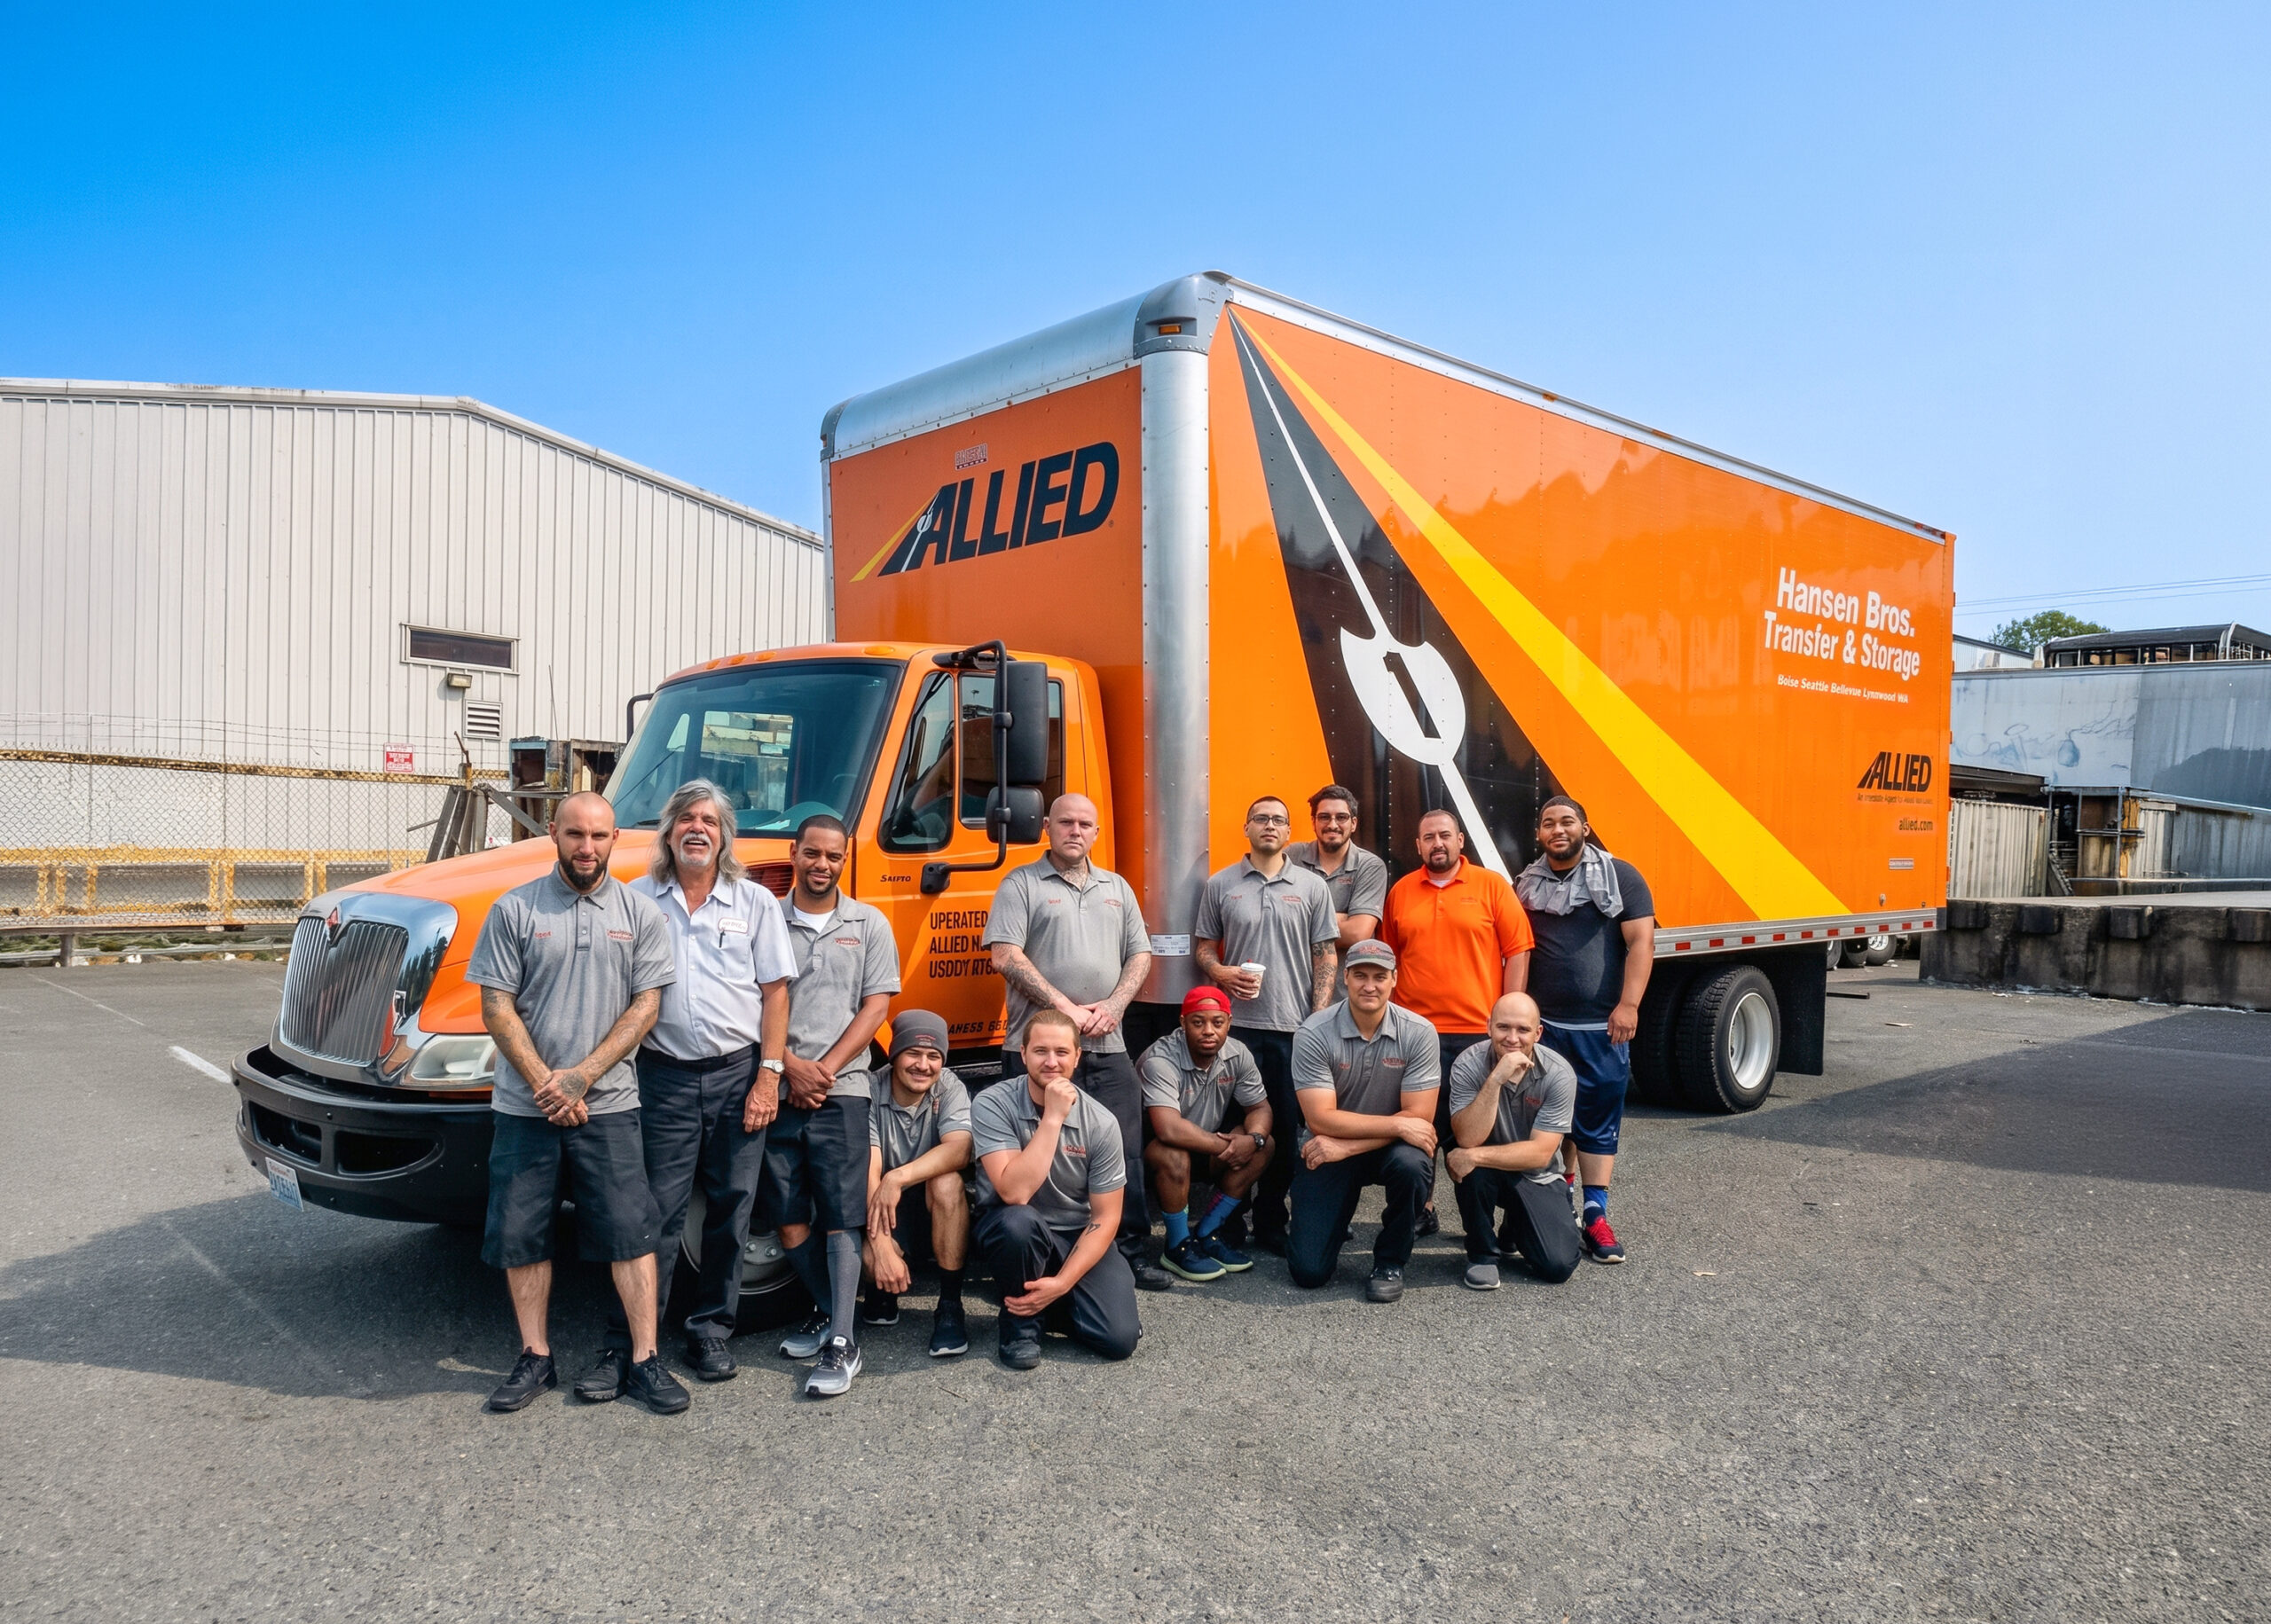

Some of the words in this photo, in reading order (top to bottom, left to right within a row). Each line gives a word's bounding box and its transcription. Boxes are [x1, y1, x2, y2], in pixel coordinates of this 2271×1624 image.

[877, 442, 1120, 577] ALLIED
[1777, 567, 1859, 624] Hansen
[1865, 591, 1915, 638] Bros.
[1843, 629, 1857, 665] &
[1861, 632, 1921, 682] Storage
[1778, 674, 1799, 688] Boise
[1831, 682, 1861, 697] Bellevue
[1863, 688, 1896, 702] Lynnwood
[1898, 693, 1909, 703] WA
[1857, 751, 1932, 792] ALLIED
[1898, 818, 1933, 831] allied.com
[929, 935, 969, 954] ALLIED
